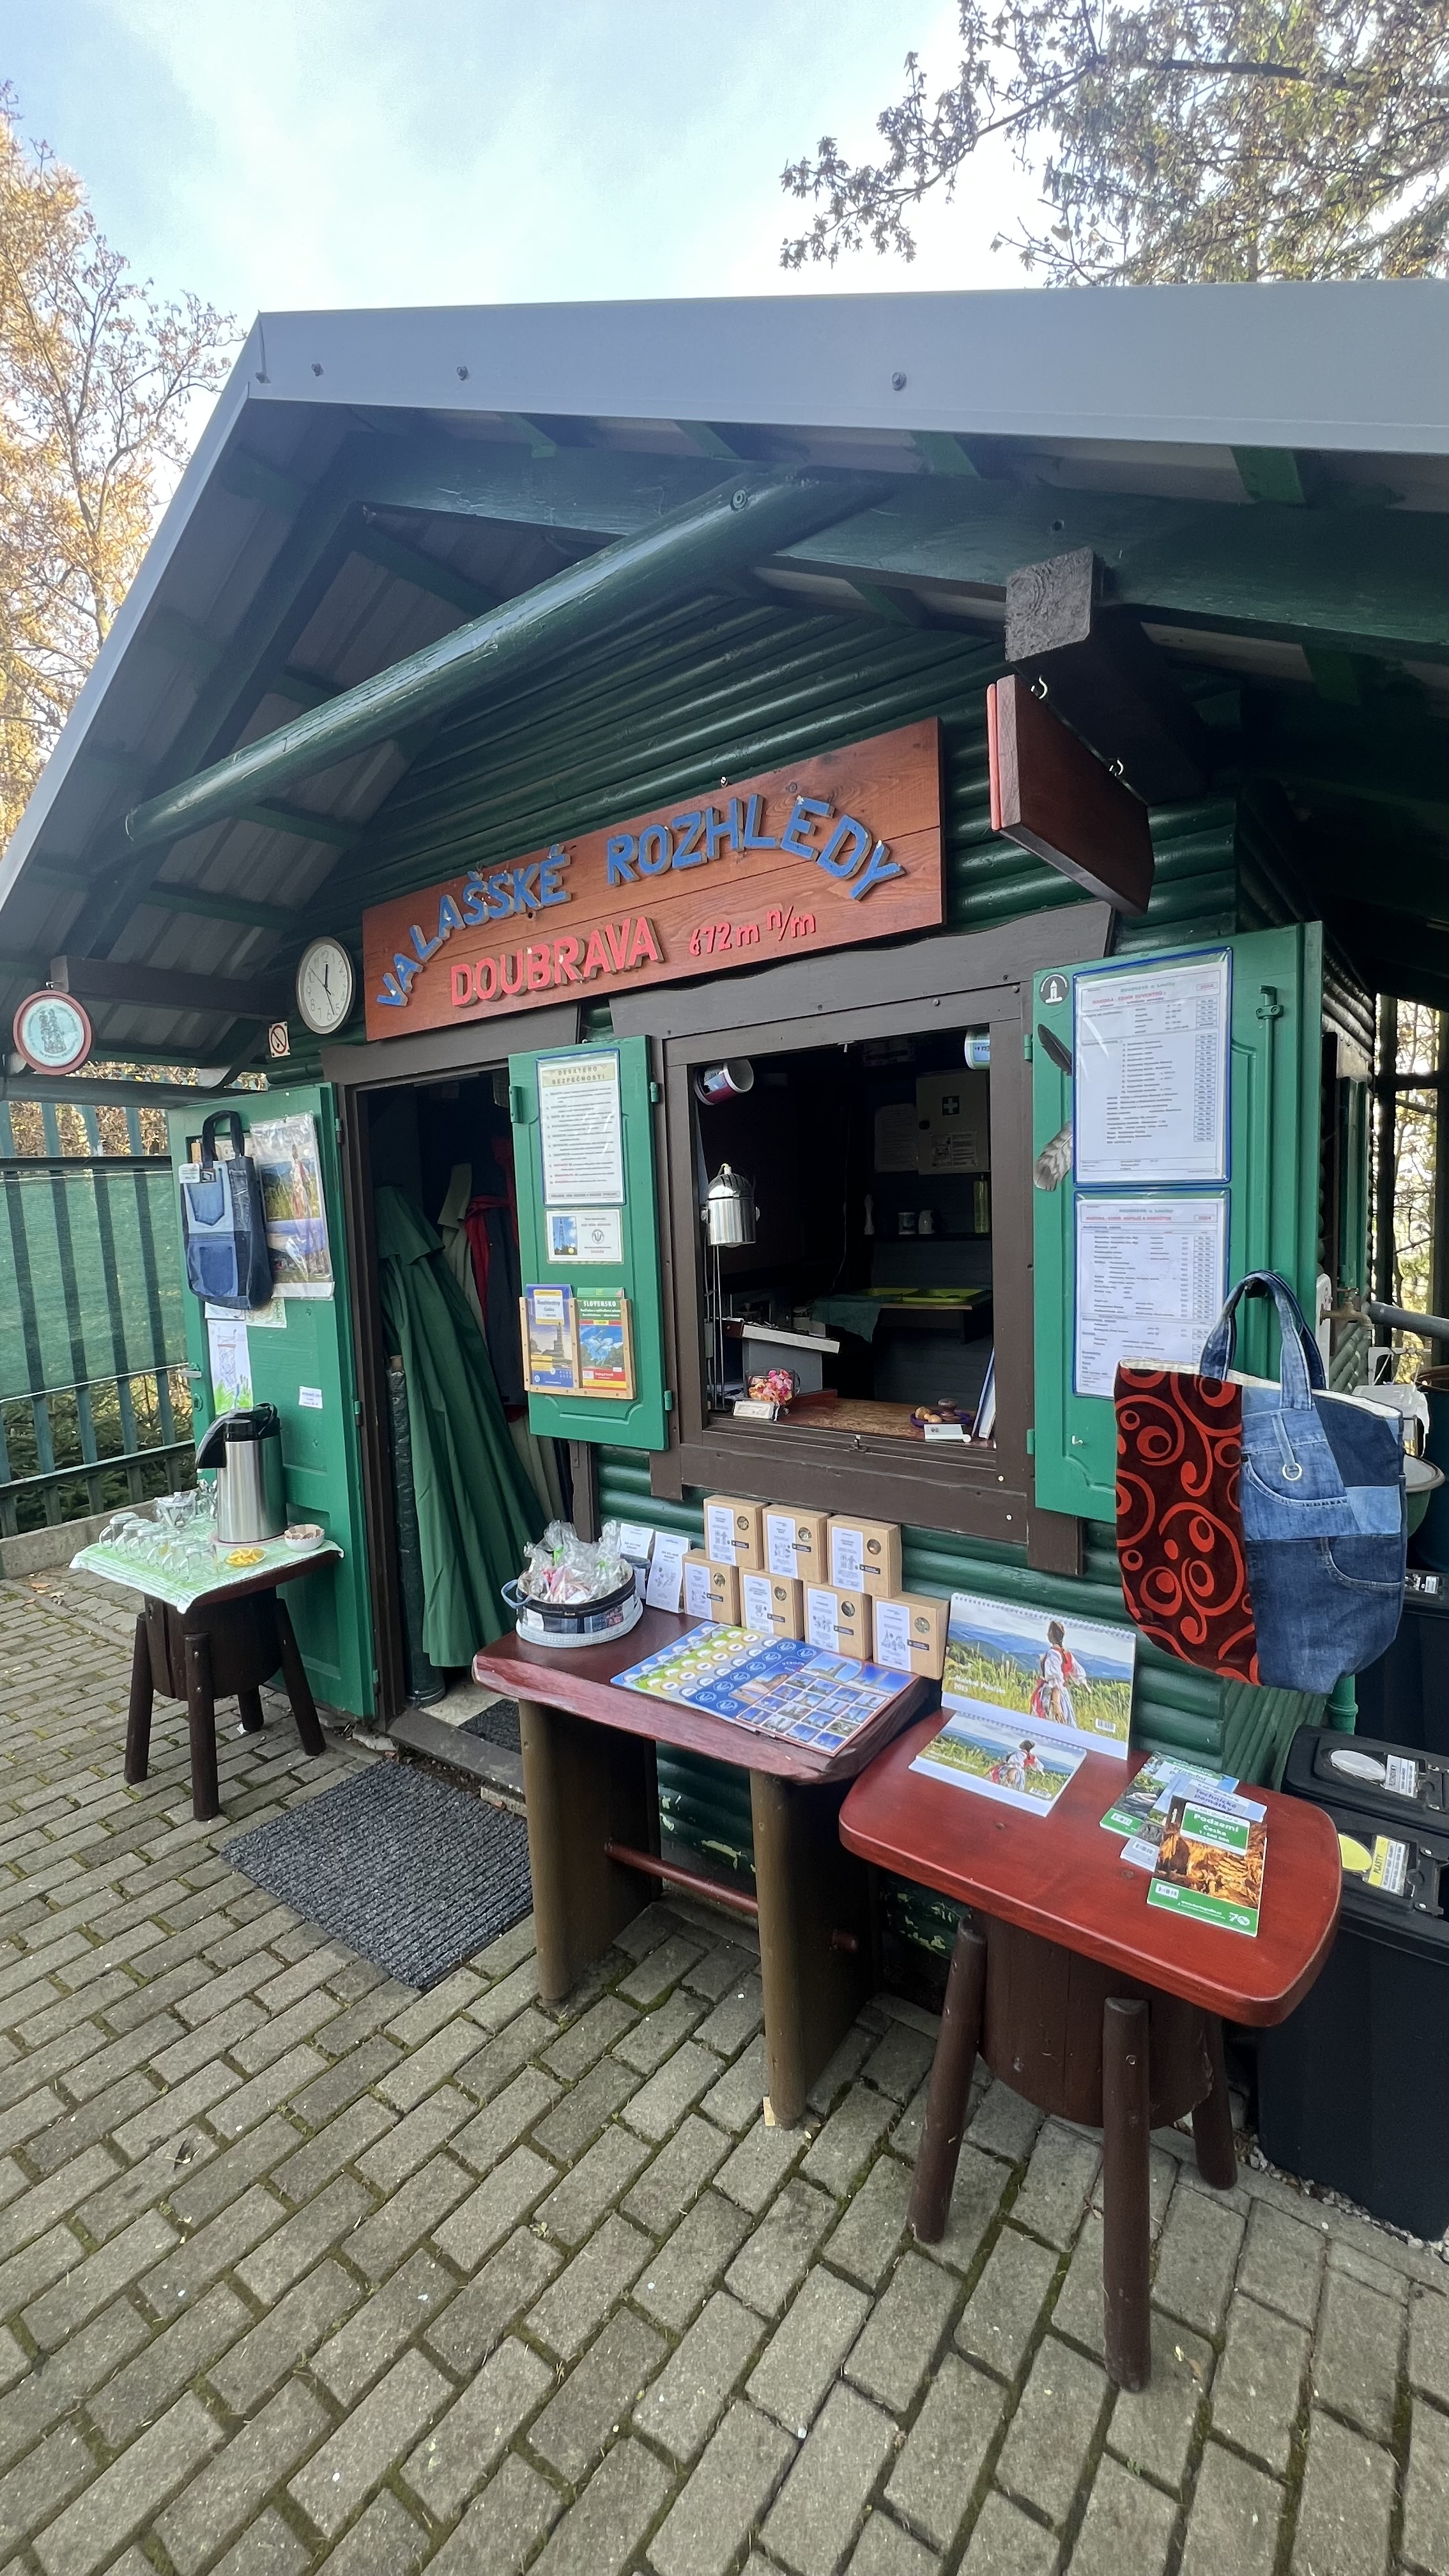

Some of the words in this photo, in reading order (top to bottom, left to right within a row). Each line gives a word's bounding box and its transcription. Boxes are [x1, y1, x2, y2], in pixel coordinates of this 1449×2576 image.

[376, 843, 571, 1007] VALAŠSKÉ
[606, 793, 905, 900] ROZHLEDY
[450, 916, 664, 1008] DOUBRAVA
[552, 1074, 605, 1085] BEZPEČNOSTI
[558, 1066, 598, 1076] DESATERO
[1194, 1794, 1232, 1812] památky
[1195, 1788, 1237, 1809] Technické
[1193, 1813, 1239, 1833] Podzemí
[1202, 1825, 1227, 1837] Česka
[1374, 1853, 1384, 1874] PLASTY
